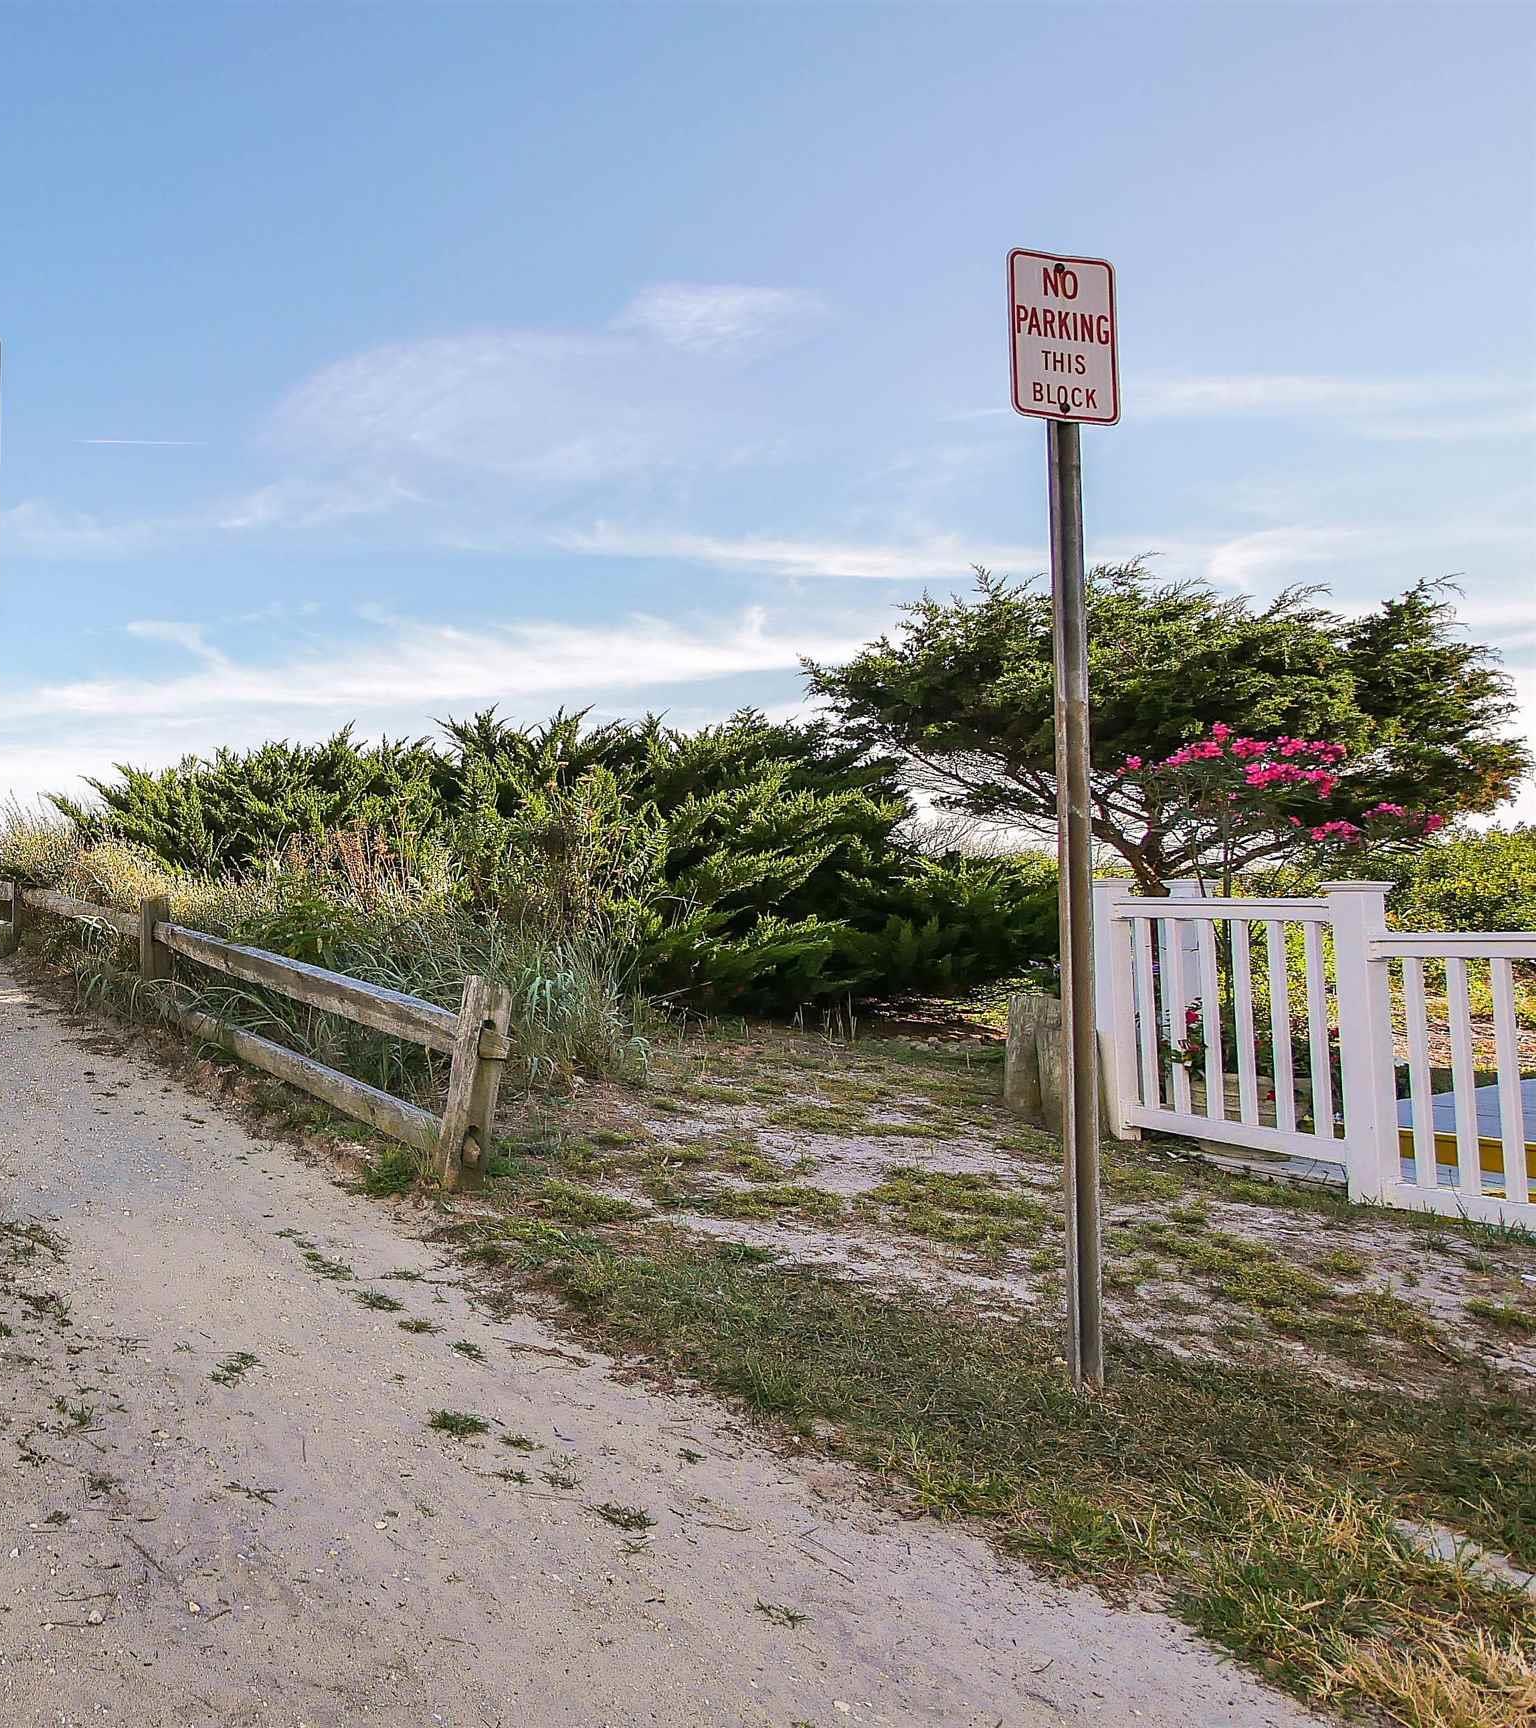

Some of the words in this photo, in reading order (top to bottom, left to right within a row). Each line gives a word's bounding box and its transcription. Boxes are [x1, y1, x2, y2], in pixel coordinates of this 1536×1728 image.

[1043, 267, 1078, 300] NO
[1016, 304, 1110, 344] PARKING
[1041, 350, 1086, 375] THIS
[1032, 382, 1097, 409] BLOCK
